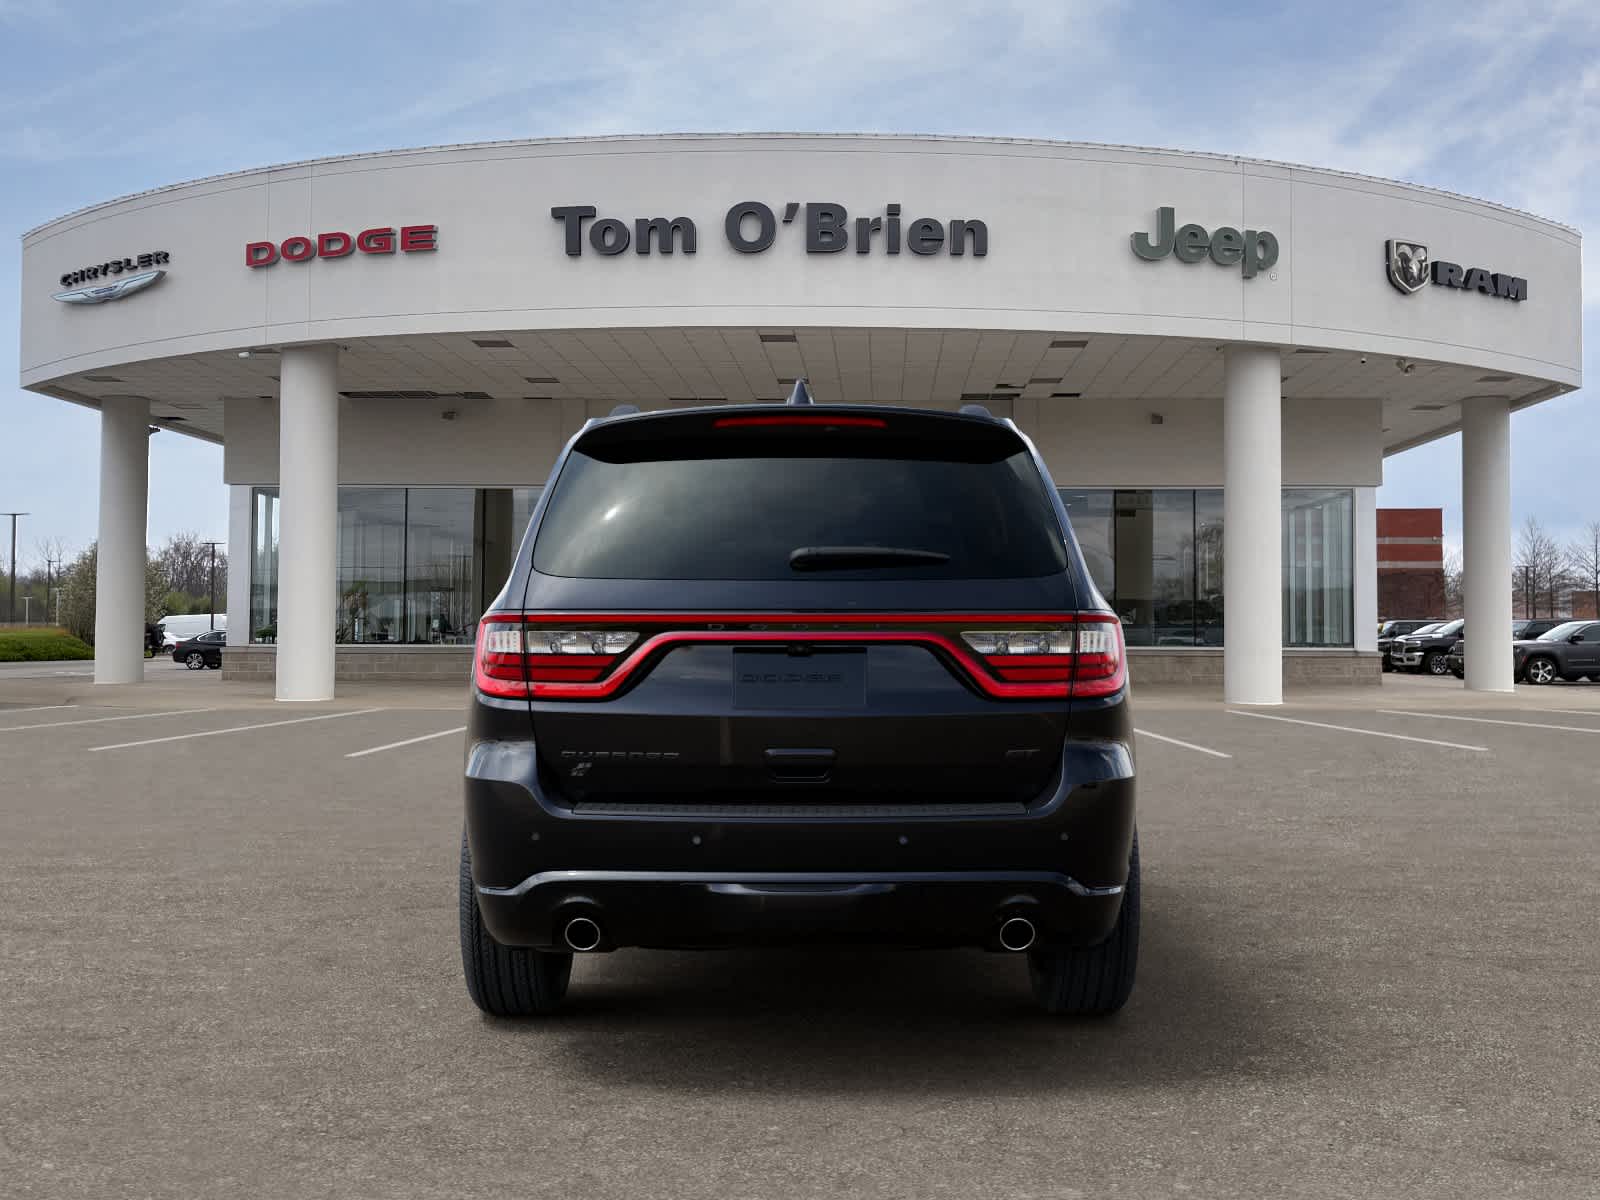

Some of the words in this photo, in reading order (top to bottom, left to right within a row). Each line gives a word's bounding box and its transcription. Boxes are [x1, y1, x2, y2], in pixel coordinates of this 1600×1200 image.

[245, 224, 437, 269] DODGE
[551, 205, 697, 257] Tom
[724, 200, 989, 257] O'Brien
[1130, 206, 1280, 279] Jeep
[60, 249, 170, 287] CHRYSLER
[1431, 260, 1528, 302] RAM
